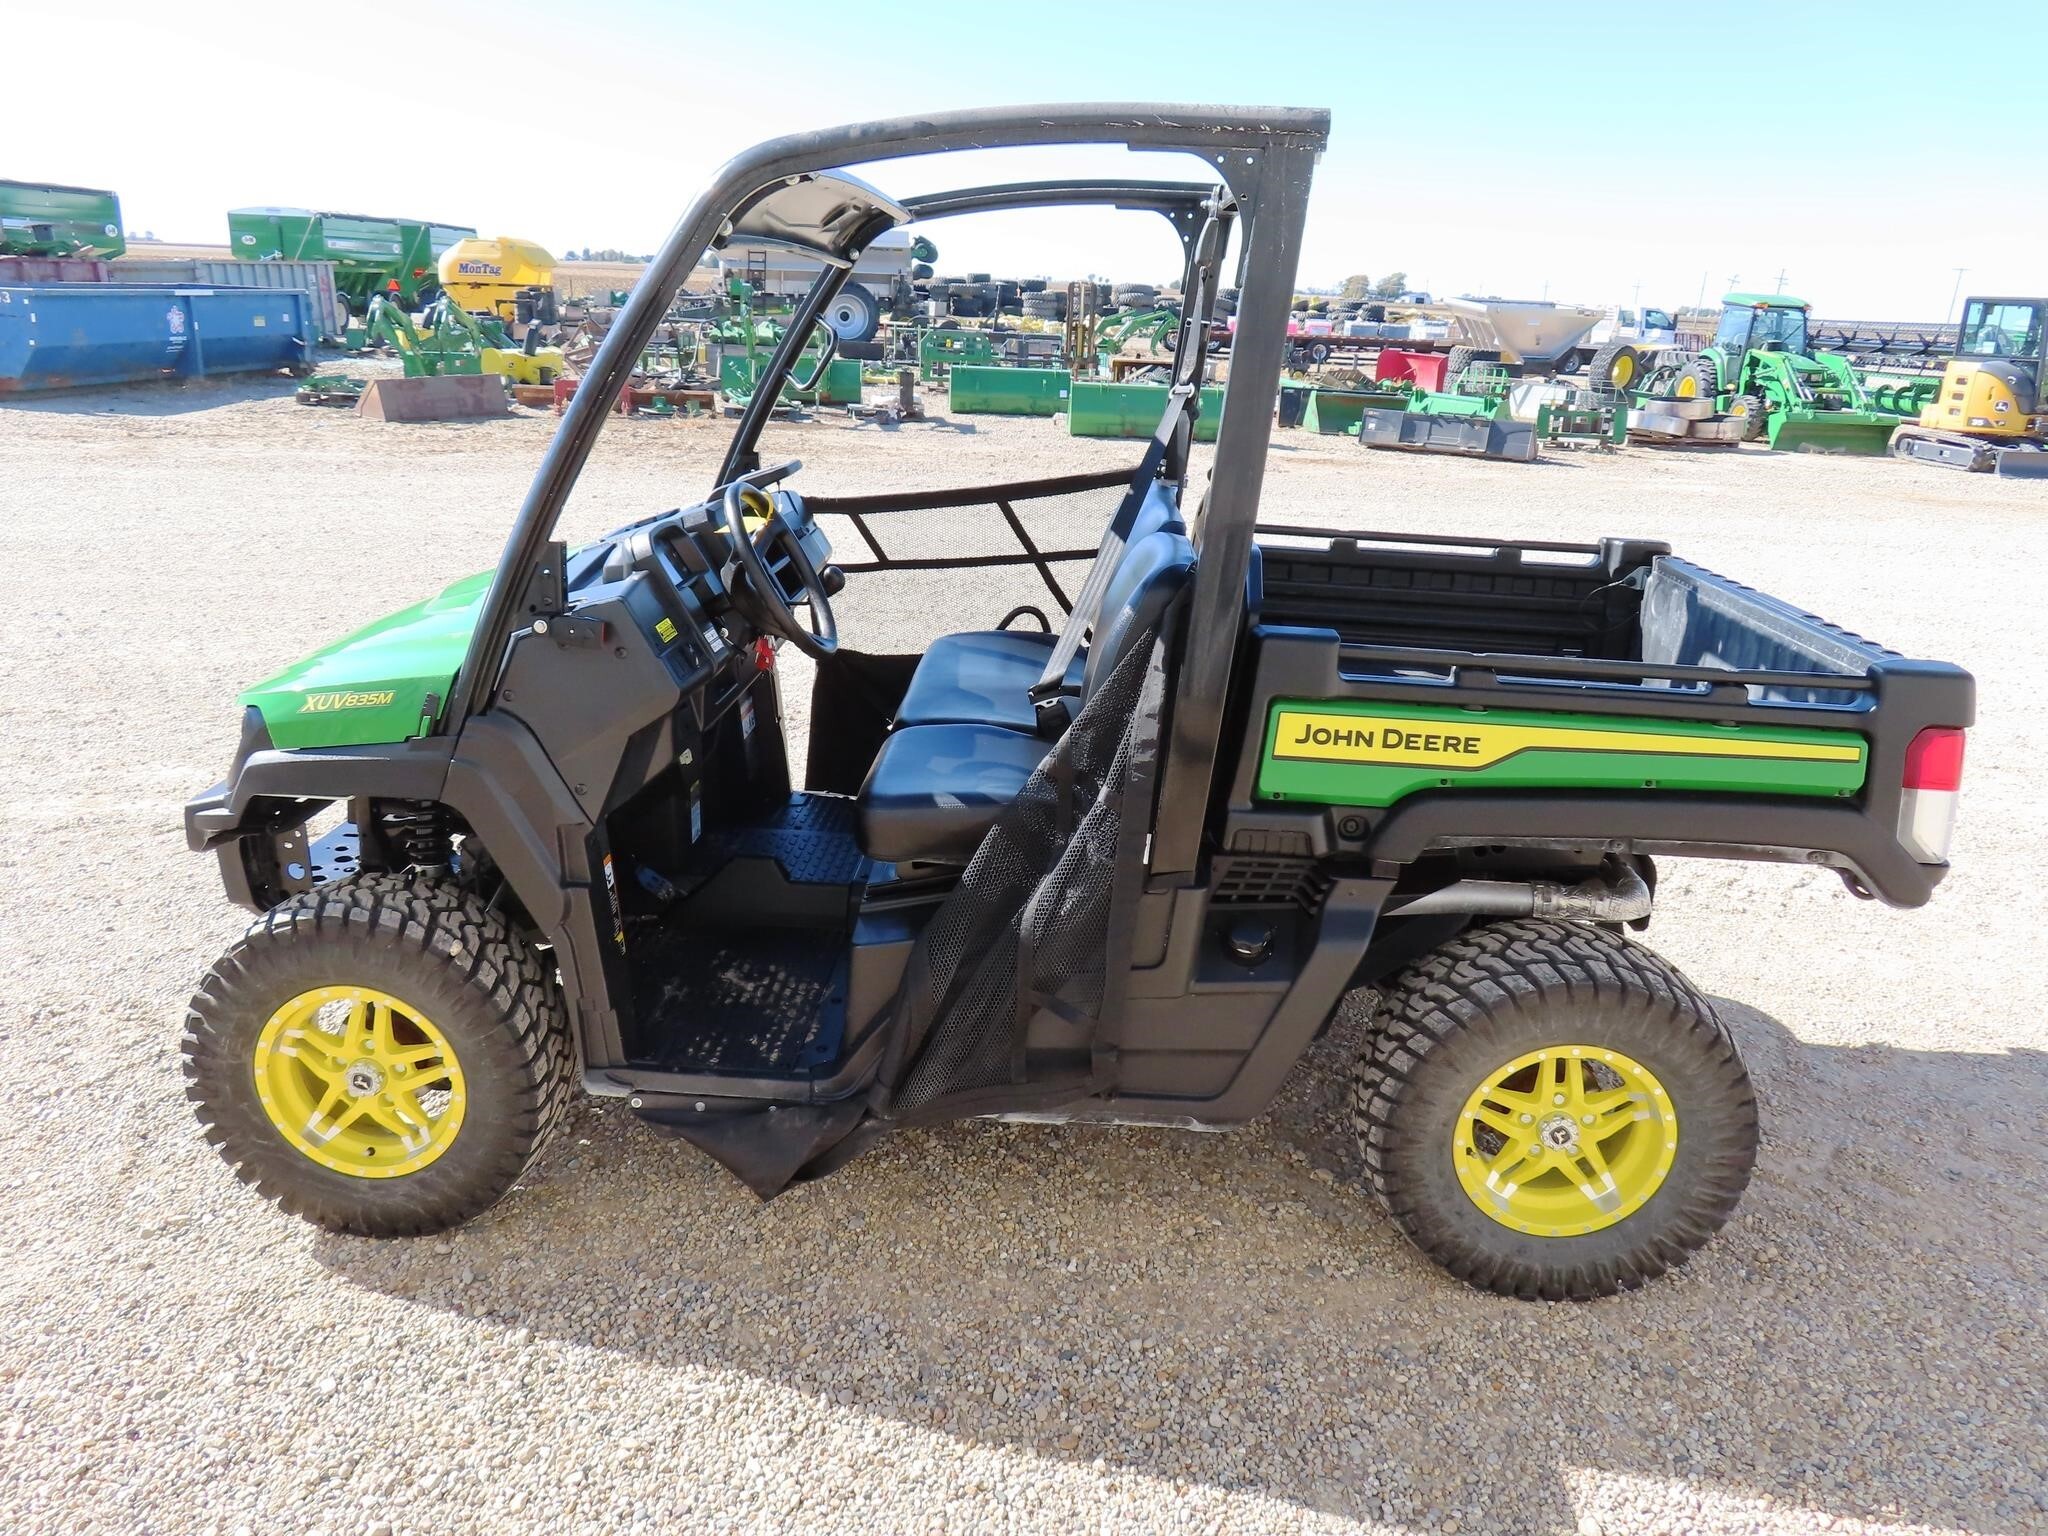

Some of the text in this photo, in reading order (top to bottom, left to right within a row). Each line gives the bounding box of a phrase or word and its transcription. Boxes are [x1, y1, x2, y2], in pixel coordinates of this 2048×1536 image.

[458, 263, 502, 276] MonTag
[301, 692, 394, 712] XUV835M
[1295, 724, 1481, 754] JOHN DEERE
